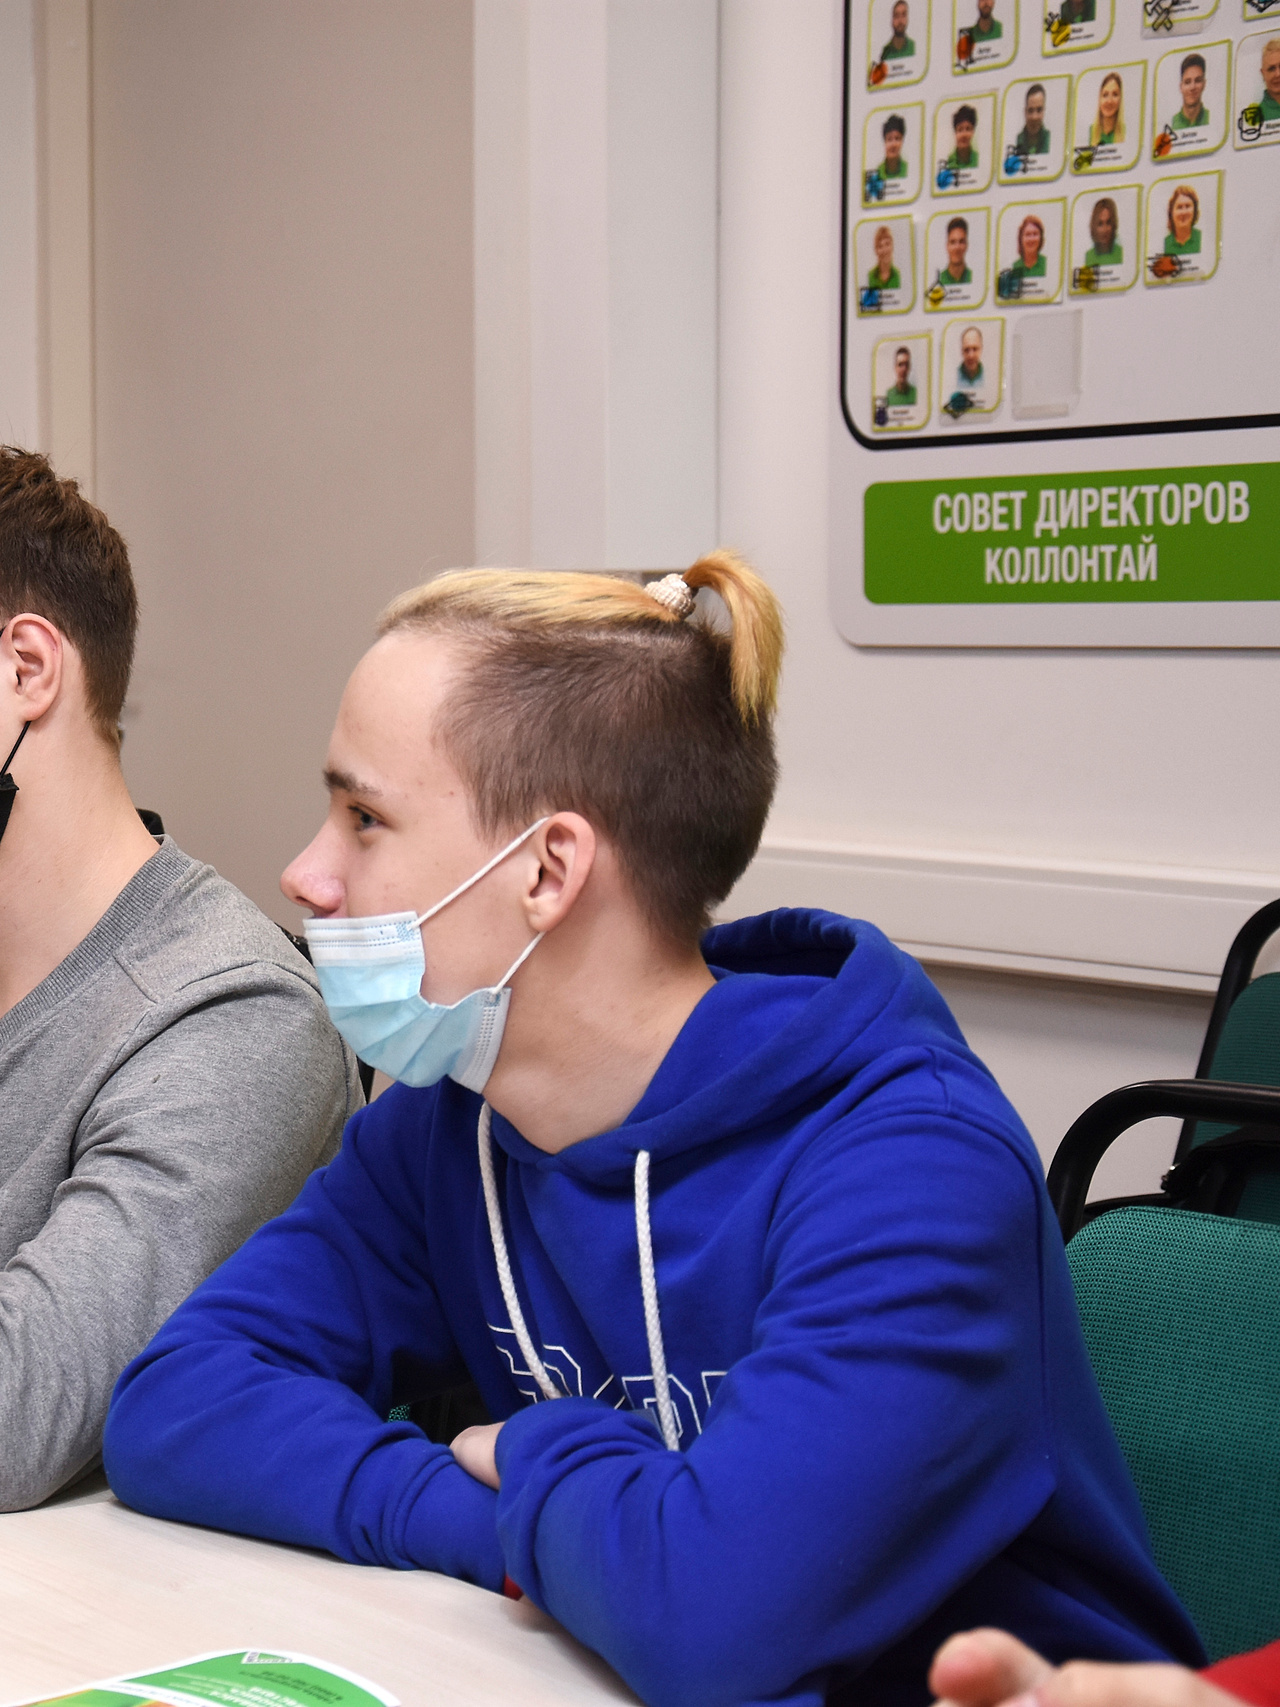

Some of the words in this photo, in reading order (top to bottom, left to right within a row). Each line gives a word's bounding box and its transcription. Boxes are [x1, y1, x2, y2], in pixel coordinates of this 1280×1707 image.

[932, 490, 1027, 534] СОВЕТ
[1033, 480, 1250, 538] ДИРЕКТОРОВ
[984, 534, 1158, 584] КОЛЛОНТАЙ
